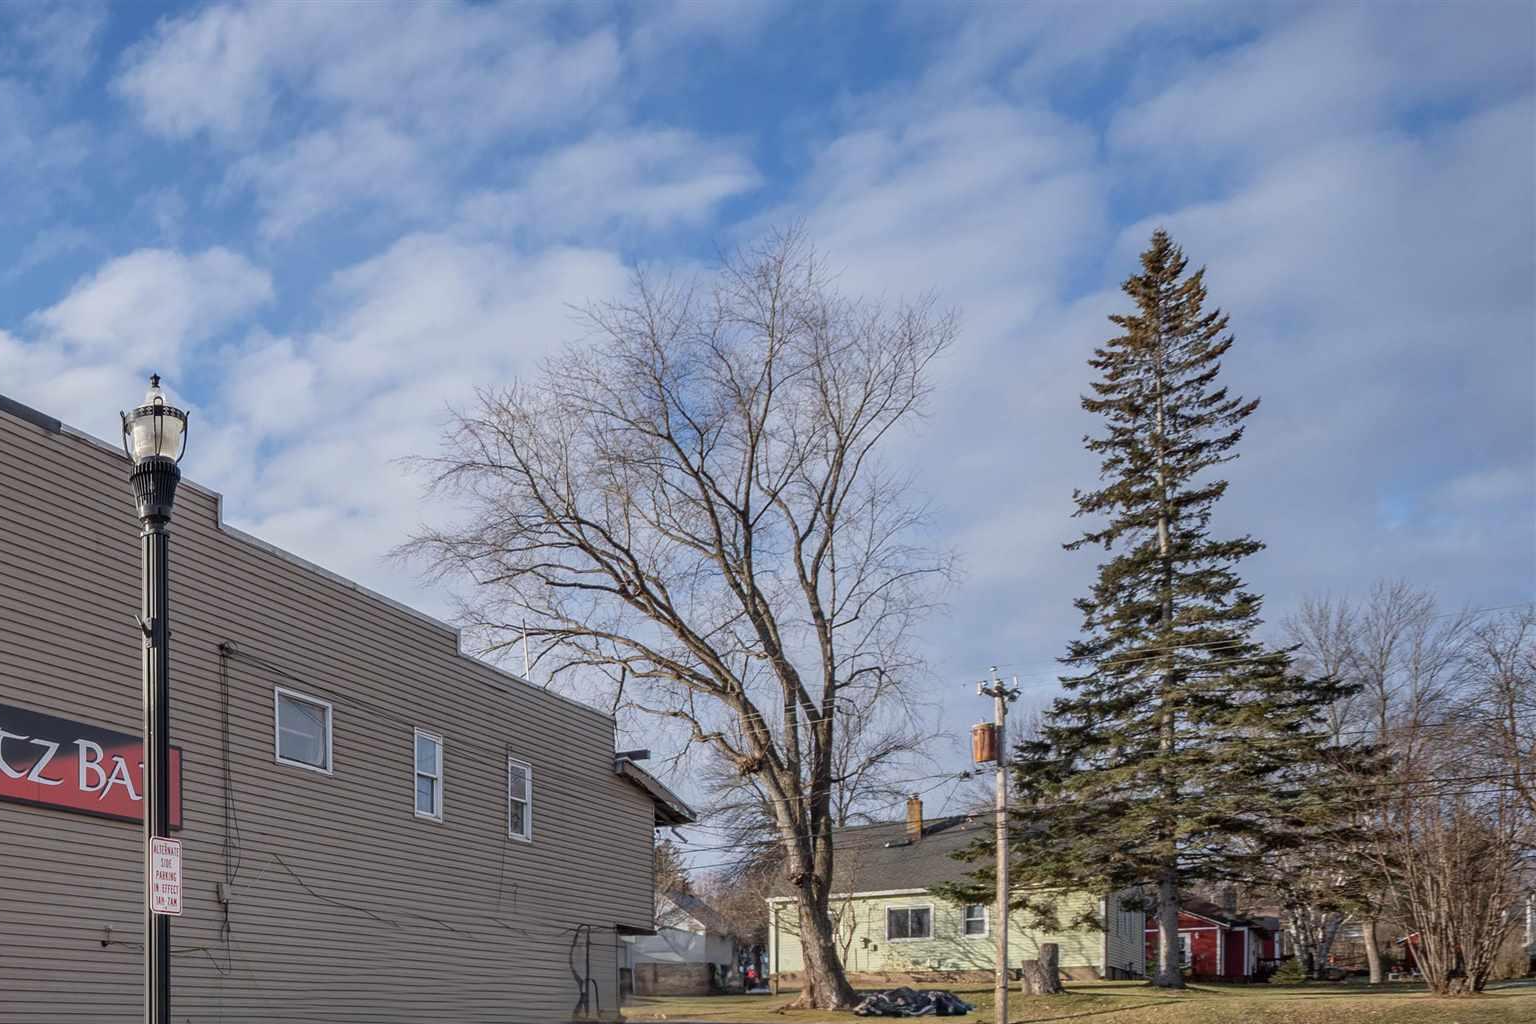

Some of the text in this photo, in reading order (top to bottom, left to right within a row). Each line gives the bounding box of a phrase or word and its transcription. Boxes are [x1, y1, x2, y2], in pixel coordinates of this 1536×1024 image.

[73, 738, 144, 801] BA
[154, 844, 179, 857] ALTERNATE
[160, 858, 172, 869] SIDE
[156, 870, 177, 882] PARKING
[153, 883, 179, 897] IN EFFECT
